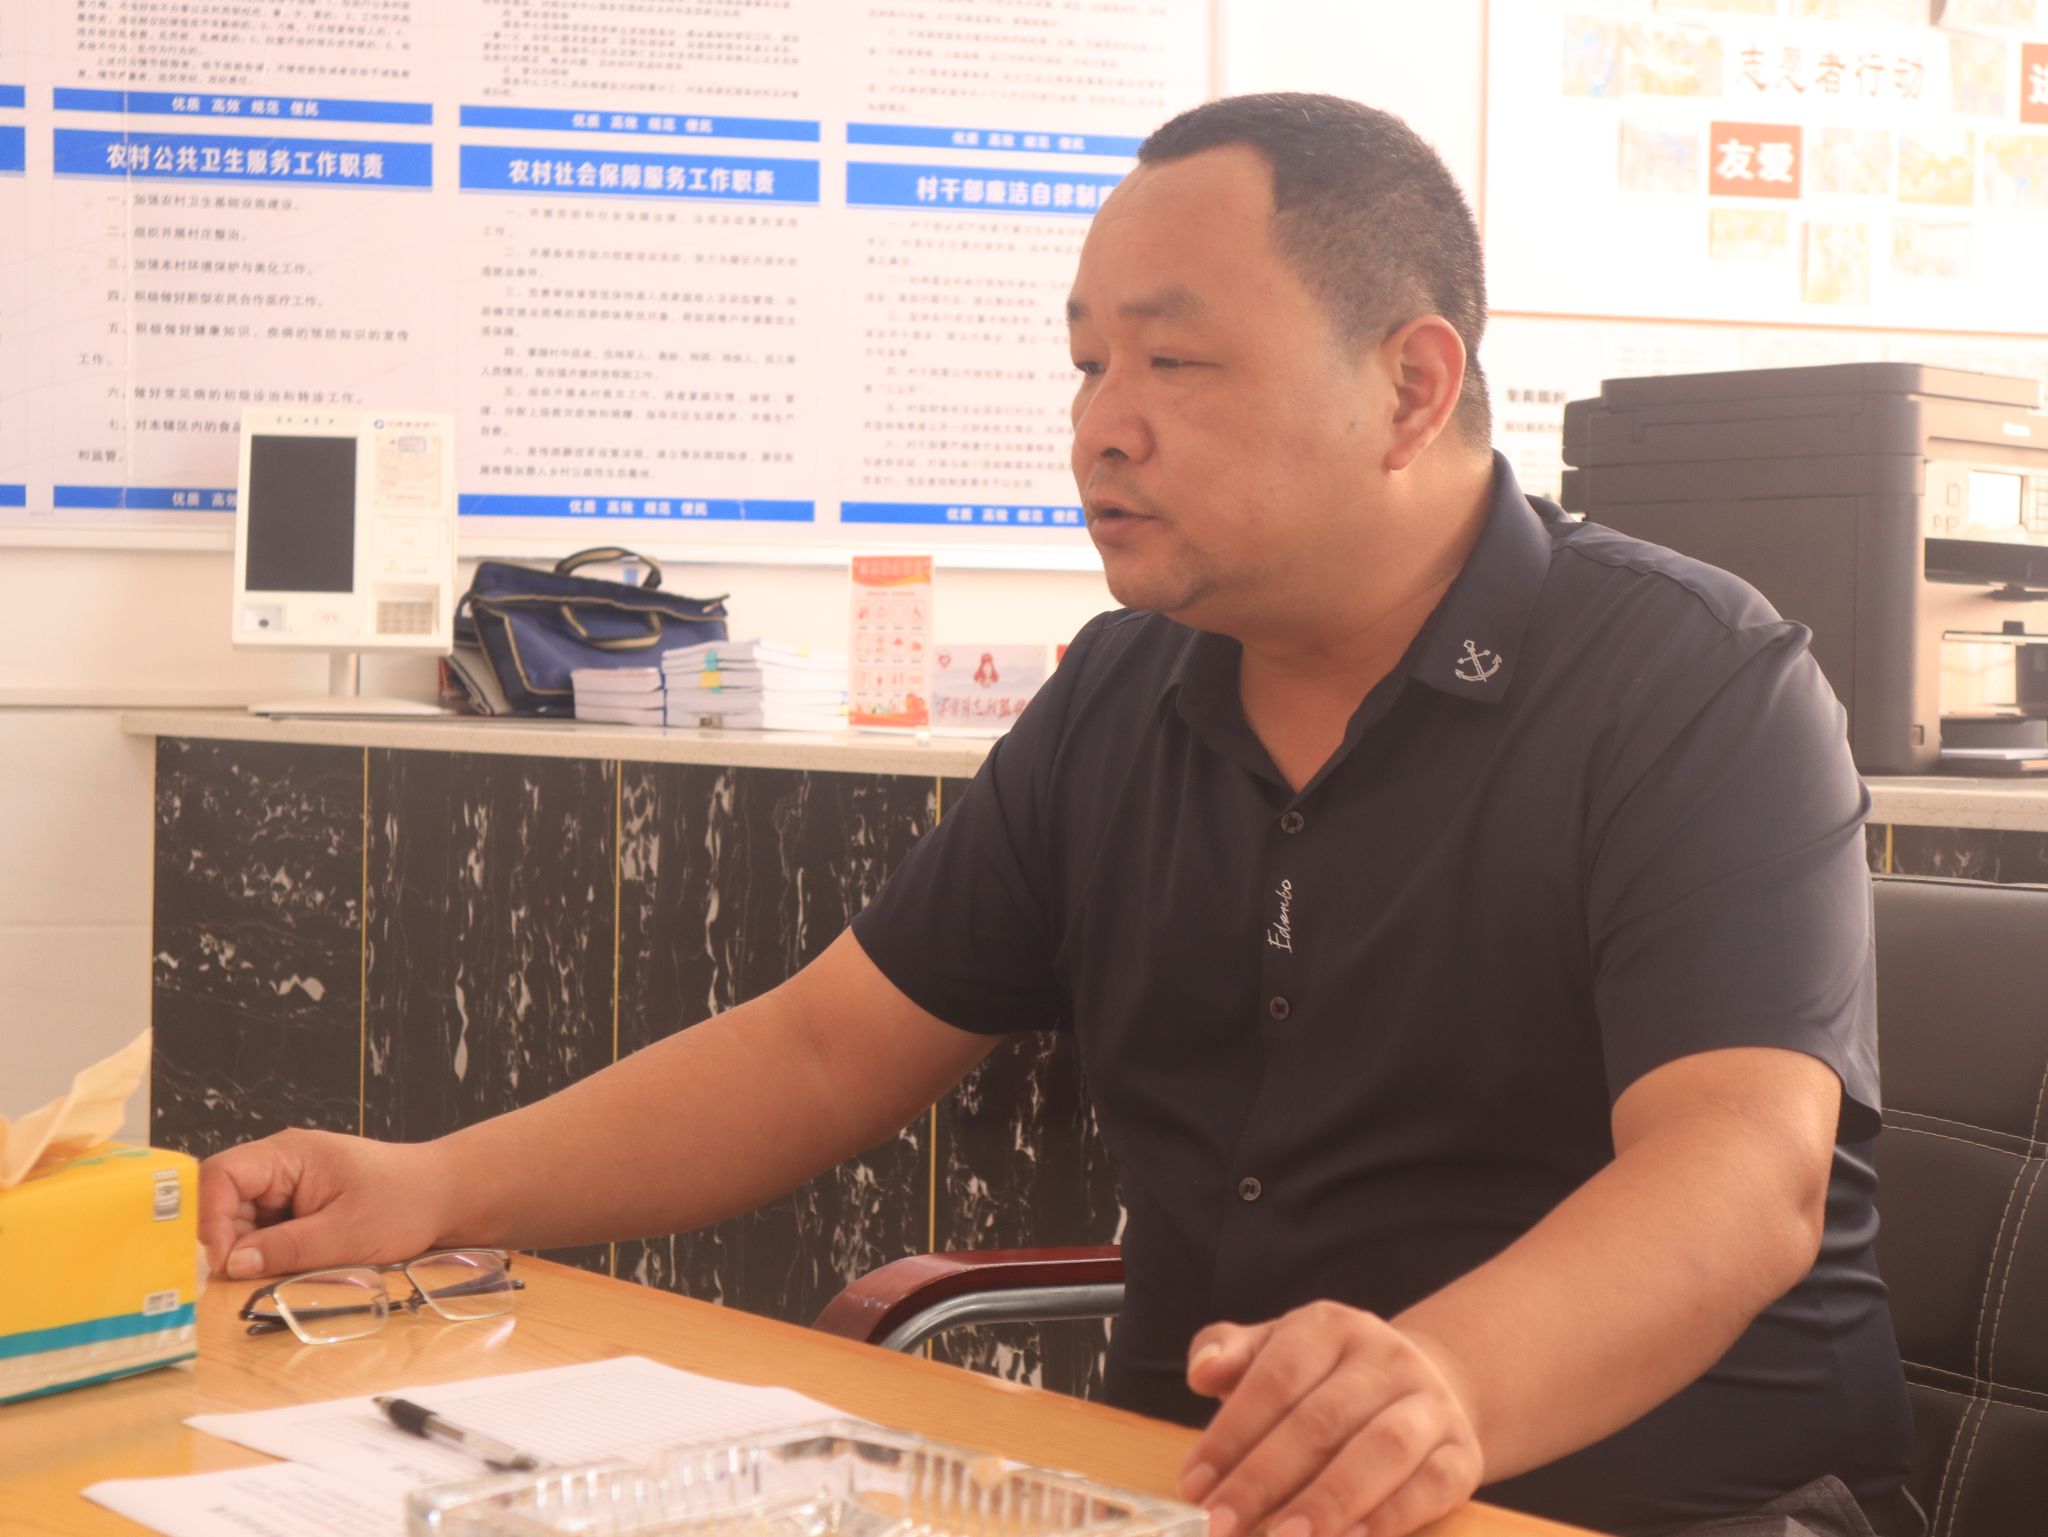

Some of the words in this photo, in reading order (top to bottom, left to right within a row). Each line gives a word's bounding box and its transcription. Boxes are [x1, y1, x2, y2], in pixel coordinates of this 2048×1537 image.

[1736, 42, 1925, 99] 志愿者行动
[172, 97, 200, 113] 优质
[211, 98, 241, 114] 高效
[572, 113, 600, 129] 优质
[610, 114, 638, 131] 高效
[106, 144, 384, 179] 农村公共卫生服务工作职责
[508, 159, 775, 195] 农村社会保障服务工作职责
[1717, 139, 1794, 183] 友爱
[606, 501, 633, 515] 高效
